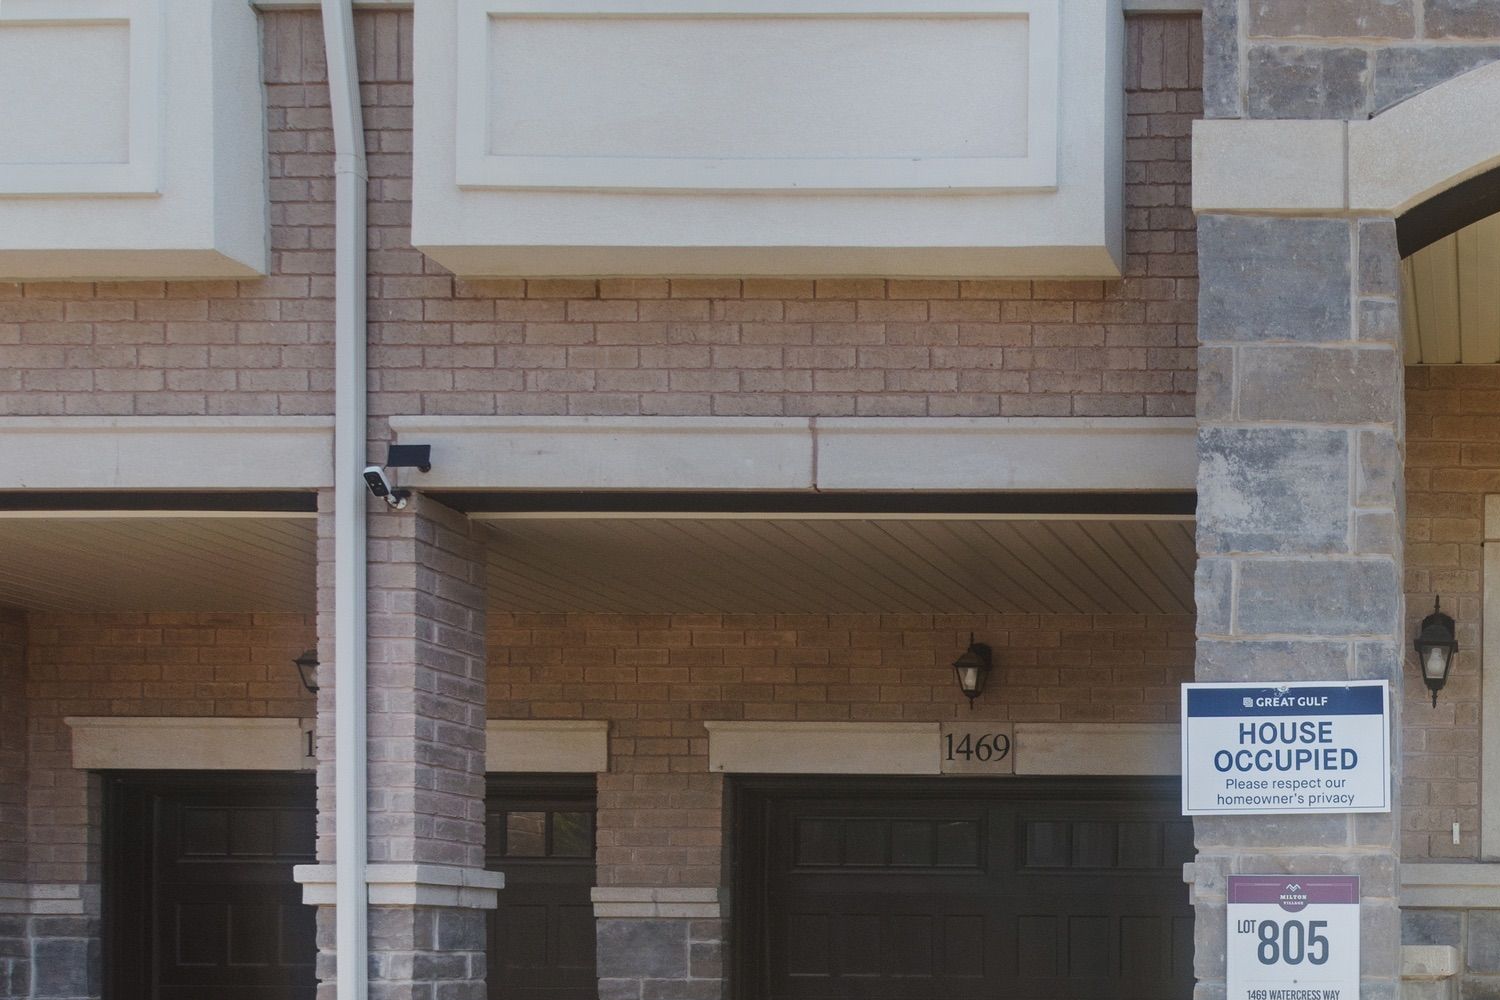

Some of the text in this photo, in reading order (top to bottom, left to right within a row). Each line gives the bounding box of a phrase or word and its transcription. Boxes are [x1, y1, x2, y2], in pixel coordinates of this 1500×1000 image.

[1256, 696, 1328, 708] GREAT GULF
[1239, 721, 1333, 745] HOUSE
[945, 733, 1010, 761] 1469
[1214, 748, 1358, 772] OCCUPIED
[1226, 778, 1346, 791] Please respect our
[1217, 792, 1355, 807] homeowner's privacy
[1237, 920, 1329, 965] LOT 805
[1247, 990, 1340, 1000] 1469 WATERCRESS WAY
